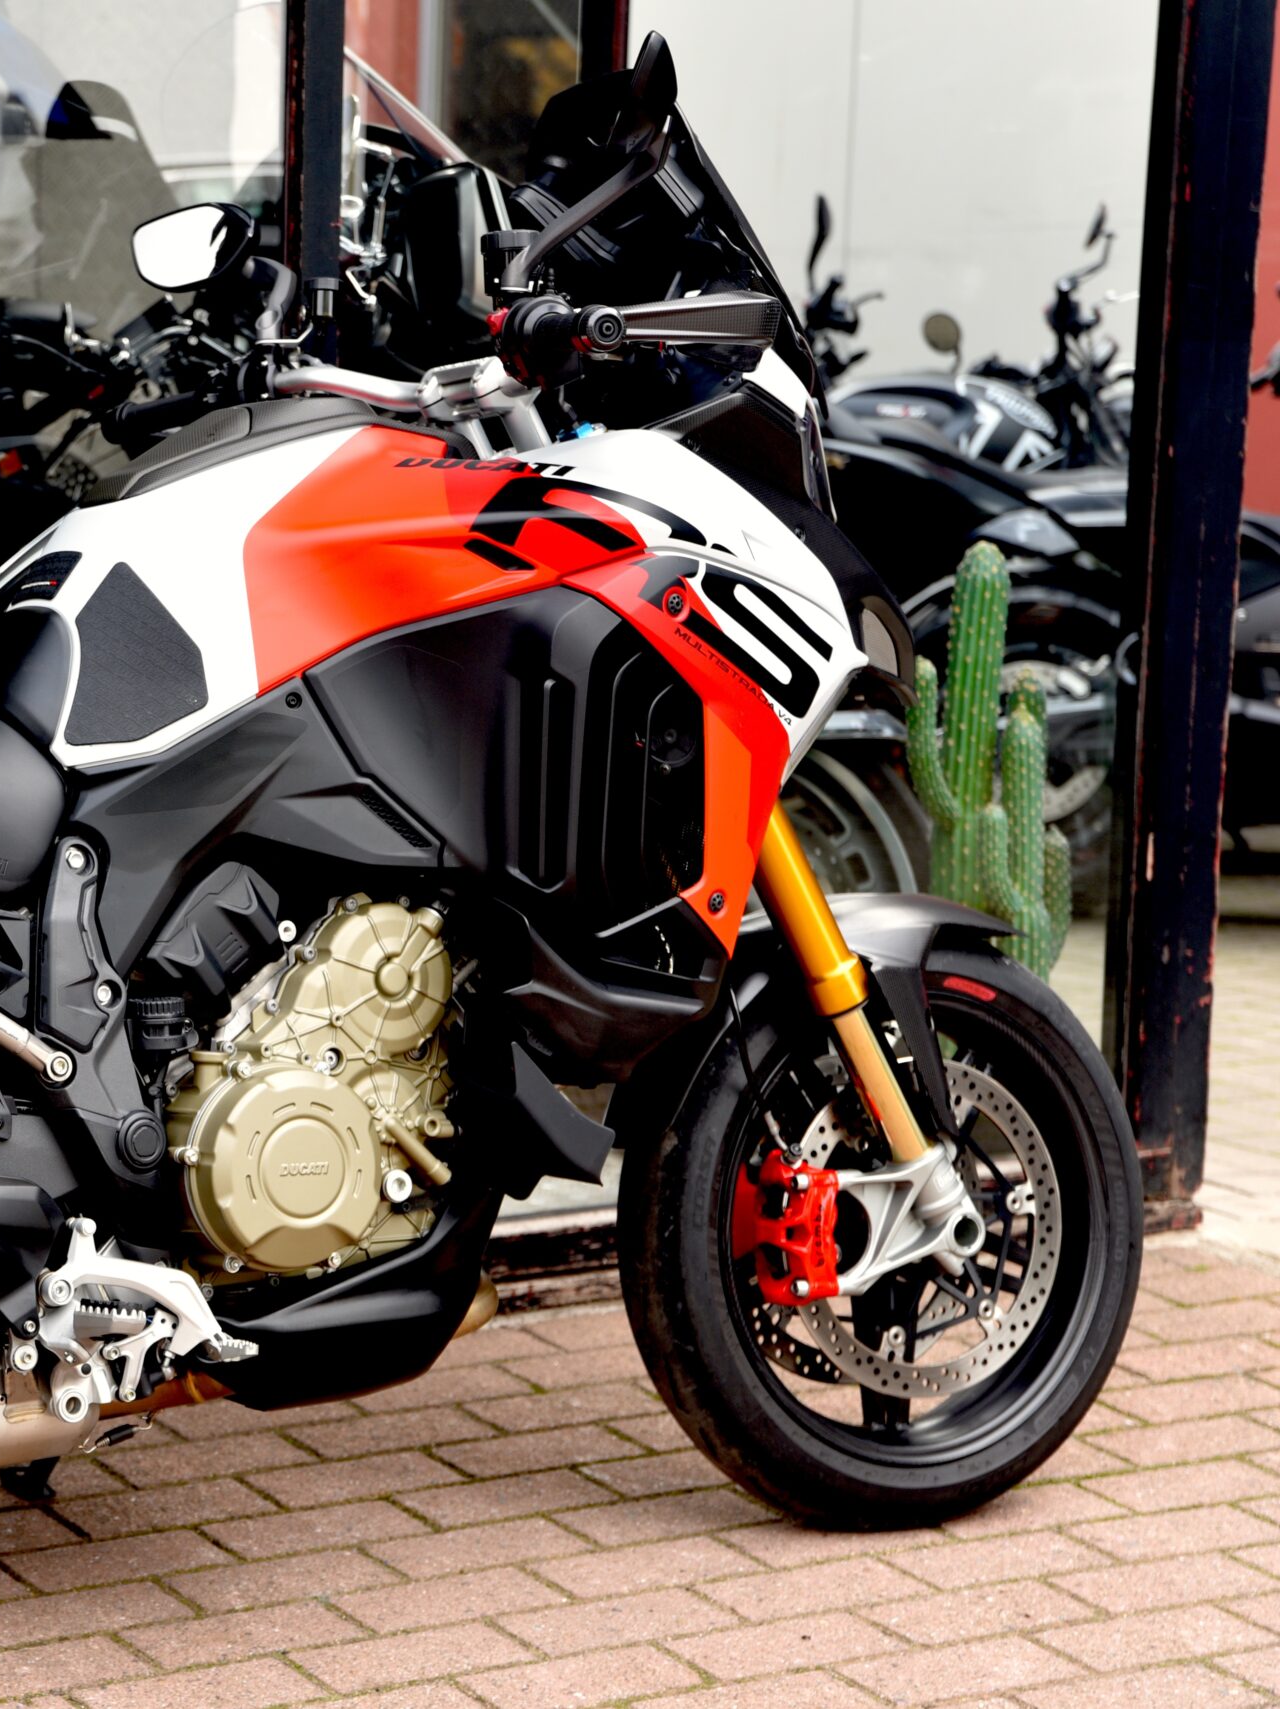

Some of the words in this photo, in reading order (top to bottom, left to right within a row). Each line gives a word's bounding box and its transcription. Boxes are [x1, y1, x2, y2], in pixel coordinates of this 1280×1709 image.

[394, 457, 576, 477] DUCATI
[674, 627, 775, 711] MULTISTRADA
[778, 710, 793, 726] V4
[279, 1161, 330, 1177] DUCATI
